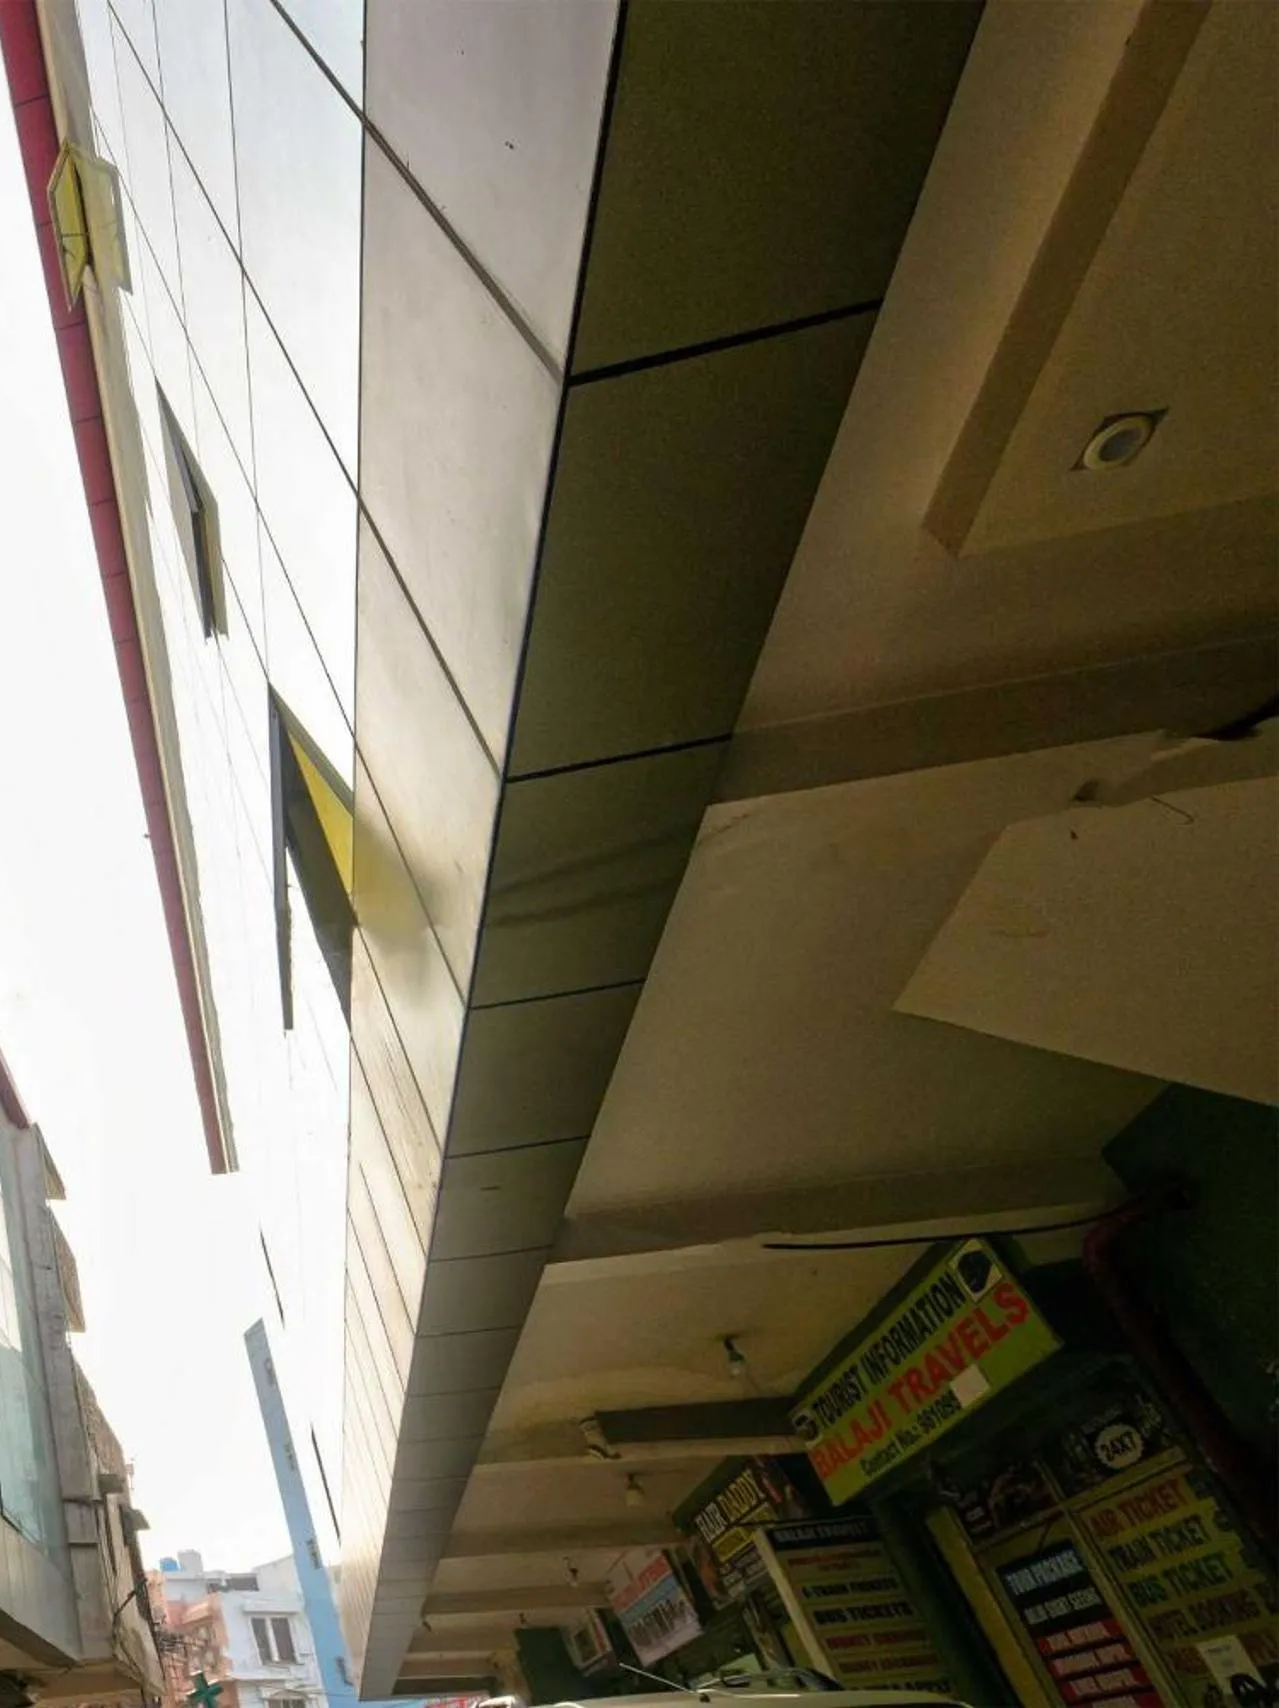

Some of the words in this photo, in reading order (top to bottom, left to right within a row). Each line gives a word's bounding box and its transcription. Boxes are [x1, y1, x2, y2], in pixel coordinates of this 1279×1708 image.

[812, 1364, 867, 1428] TOURIST
[861, 1271, 966, 1385] INFORMATION
[811, 1400, 893, 1480] BALAJI
[887, 1283, 1030, 1414] TRAVELS
[1117, 1478, 1188, 1527] TICKET
[1148, 1513, 1211, 1554] TICKET
[1162, 1551, 1234, 1597] TICKET
